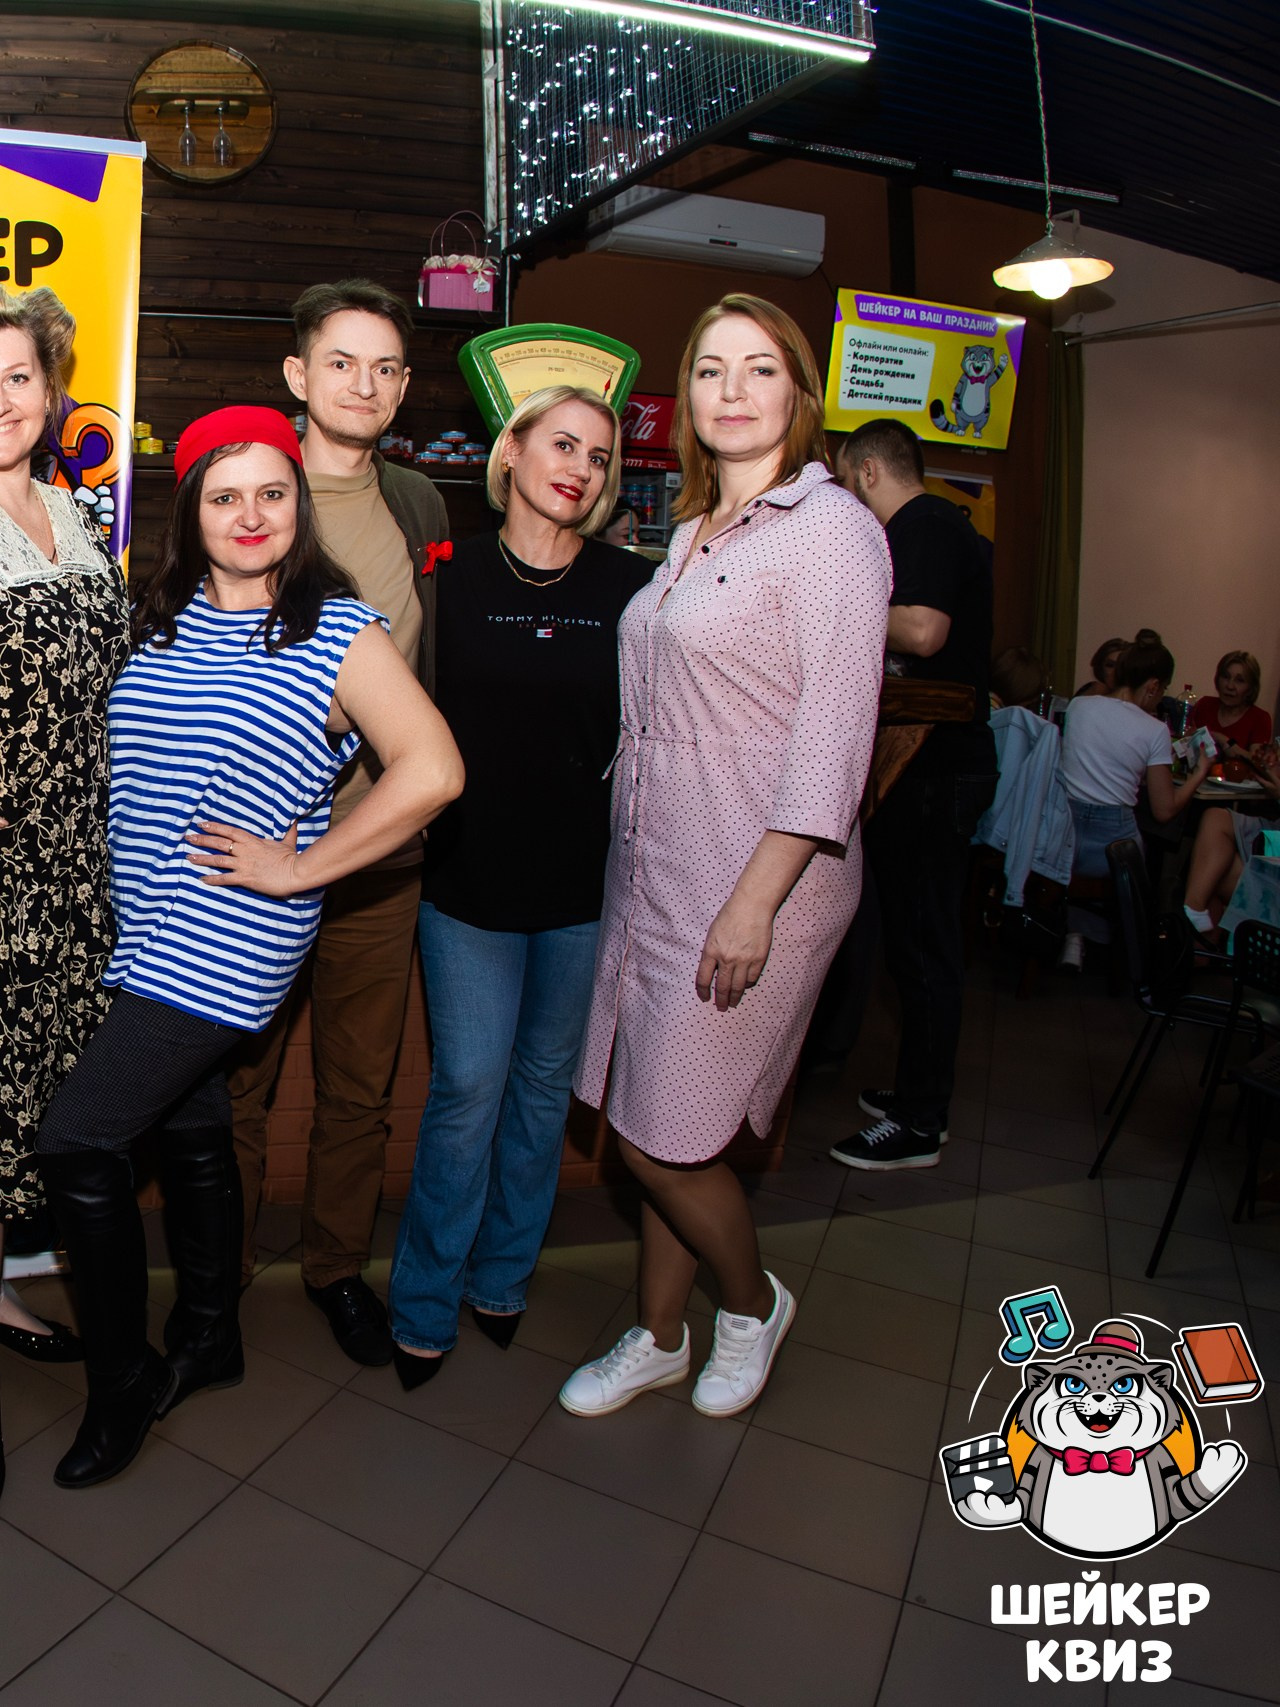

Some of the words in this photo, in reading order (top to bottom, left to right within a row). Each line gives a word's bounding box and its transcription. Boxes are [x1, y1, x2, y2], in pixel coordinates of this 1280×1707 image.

[859, 301, 901, 317] ШЕЙКЕР
[903, 308, 916, 320] НА
[920, 310, 942, 323] ВАШ
[945, 314, 995, 332] ПРАЗДНИК
[849, 338, 882, 350] Офлайн
[899, 347, 929, 357] онлайн:
[853, 352, 903, 366] Корпоратив
[850, 364, 872, 374] День
[873, 368, 916, 380] рождения
[849, 376, 884, 388] Свадьба
[847, 389, 883, 401] Детский
[884, 395, 922, 406] праздник
[542, 615, 601, 627] HILFIGER
